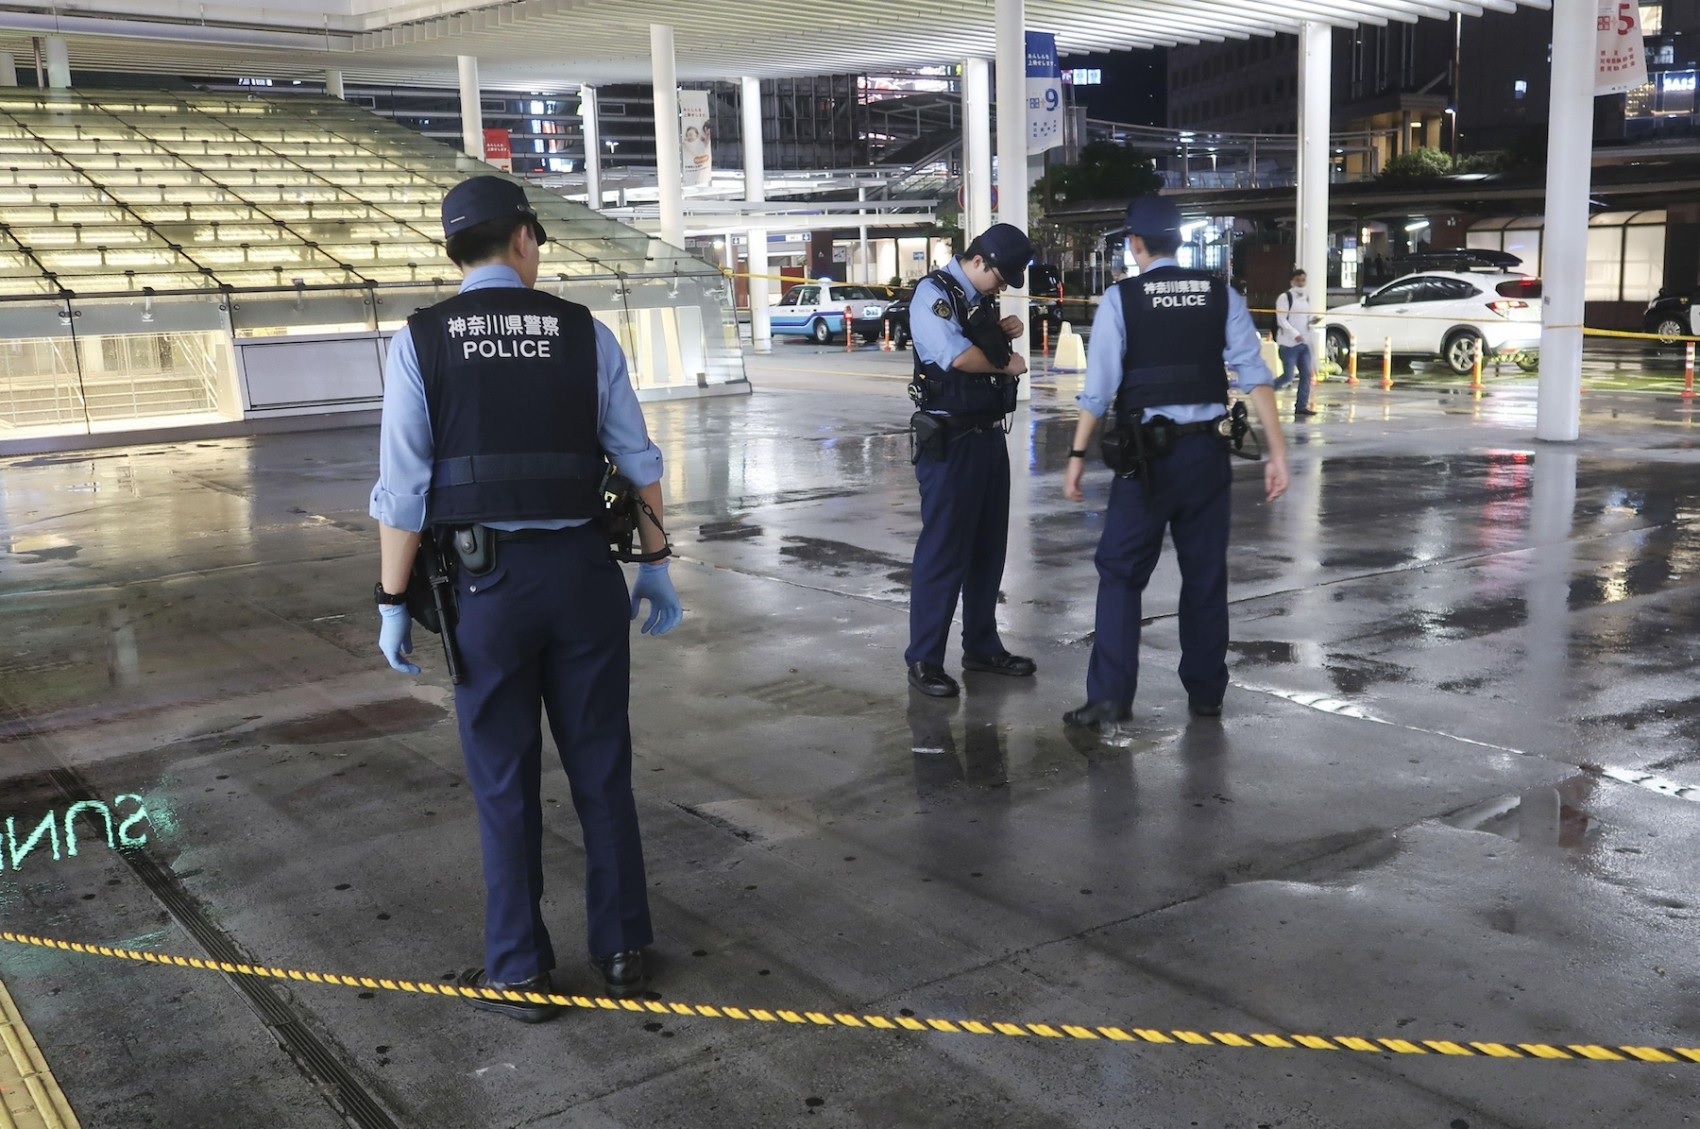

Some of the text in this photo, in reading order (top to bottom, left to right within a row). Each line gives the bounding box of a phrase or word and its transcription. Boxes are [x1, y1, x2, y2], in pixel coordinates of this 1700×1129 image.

[1617, 3, 1635, 36] 5
[1045, 88, 1059, 112] 9
[1152, 294, 1206, 308] POLICE
[447, 313, 560, 338] 神奈川県警察
[462, 339, 551, 360] POLICE
